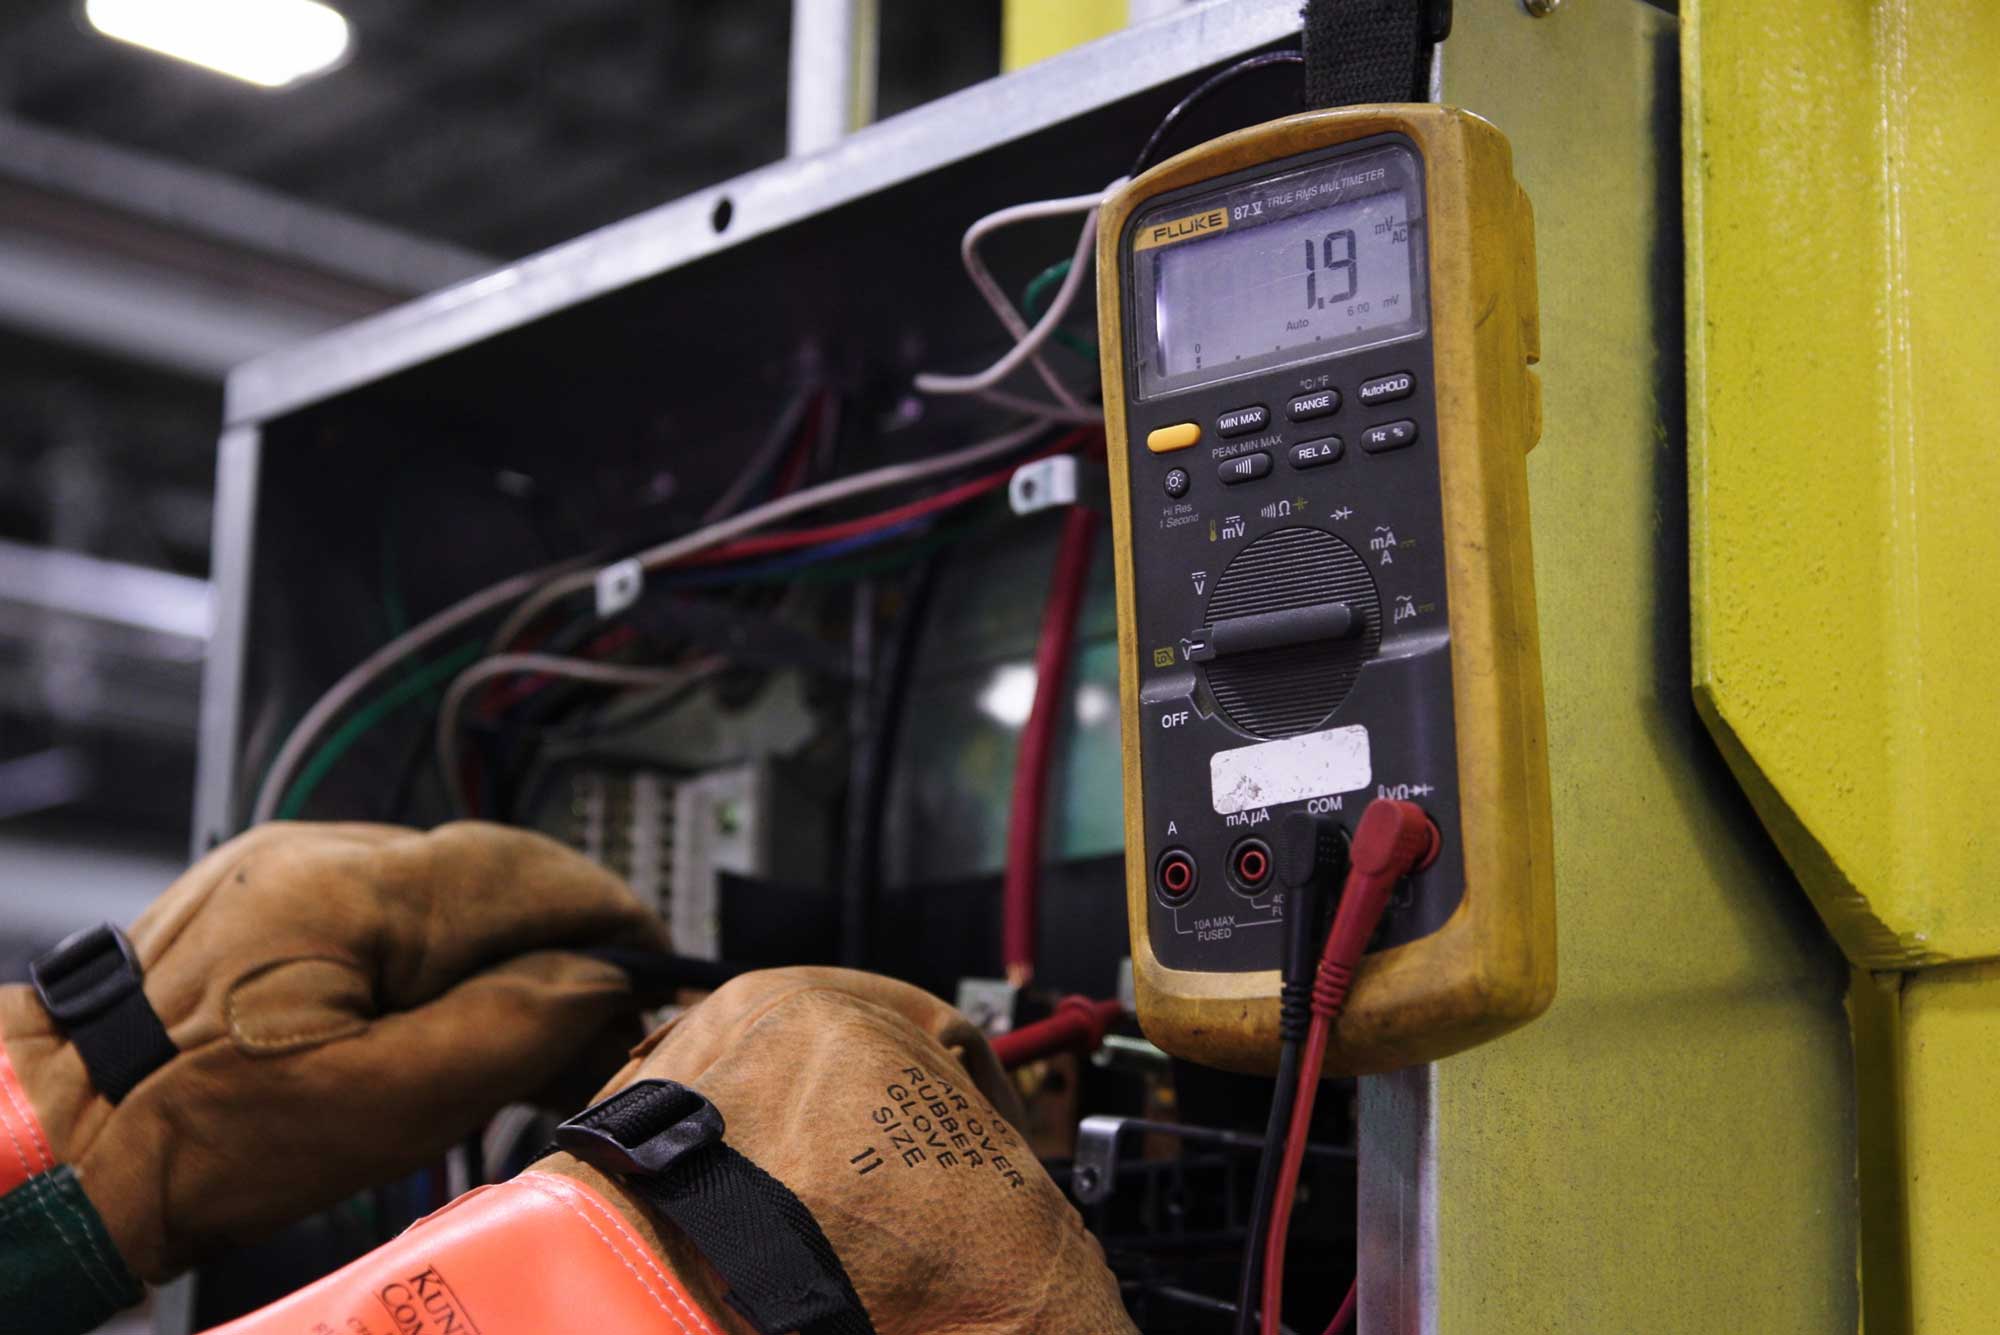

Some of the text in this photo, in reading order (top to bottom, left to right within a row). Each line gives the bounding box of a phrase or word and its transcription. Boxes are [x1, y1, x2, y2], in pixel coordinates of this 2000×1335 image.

[1153, 212, 1223, 242] FLUKE
[1267, 192, 1293, 208] TRUE
[1295, 187, 1318, 203] RMS
[1319, 168, 1385, 197] MULTIMETER
[1374, 216, 1394, 236] mV
[1392, 230, 1407, 245] AC
[1305, 228, 1358, 310] 1.9
[1383, 295, 1399, 308] mV
[1286, 318, 1310, 332] Auto
[1361, 378, 1409, 398] AutoHOLD
[1294, 396, 1329, 413] RANGE
[1220, 411, 1262, 430] MIN MAX
[1372, 430, 1386, 443] Hz
[1212, 435, 1283, 459] PEAK MIN MAX
[1298, 447, 1319, 460] REL
[1174, 503, 1192, 515] Res
[1166, 513, 1199, 529] Second
[1370, 533, 1397, 551] mA
[1380, 551, 1392, 566] A
[1161, 712, 1189, 728] OFF
[1307, 797, 1343, 814] COM
[1167, 821, 1177, 835] A
[1193, 914, 1235, 931] 10A MAX
[1198, 928, 1232, 943] FUSED
[902, 1067, 984, 1168] RUBBER
[887, 1084, 959, 1169] GLOVE
[873, 1106, 926, 1168] SIZE
[850, 1147, 884, 1176] 11
[967, 1118, 1024, 1188] OVER
[408, 1269, 468, 1335] KUN
